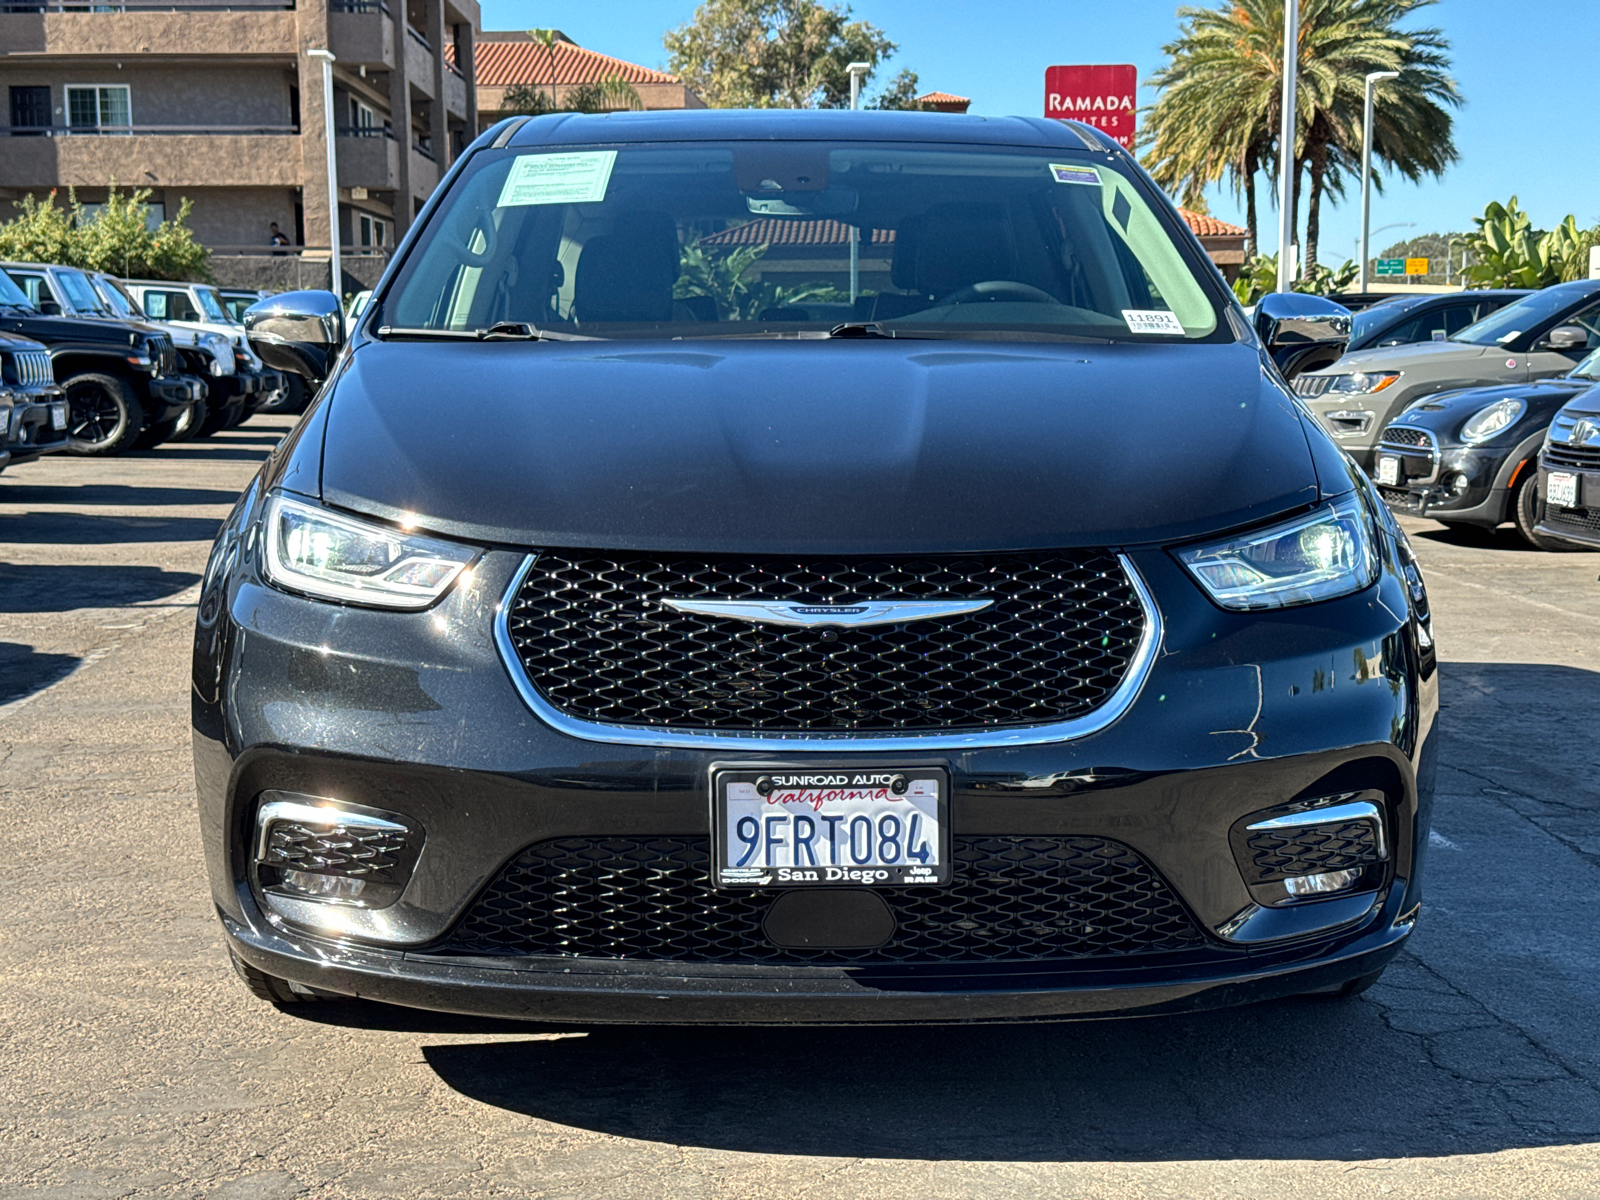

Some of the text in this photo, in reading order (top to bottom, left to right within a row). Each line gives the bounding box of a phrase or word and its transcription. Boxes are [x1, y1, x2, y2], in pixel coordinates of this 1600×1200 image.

[1049, 93, 1132, 111] RAMADA
[1060, 116, 1119, 127] ITES
[1127, 314, 1173, 323] 11891
[771, 775, 892, 786] SUNROAD AUTO
[767, 788, 904, 811] California
[736, 813, 930, 867] 9FRT084
[778, 867, 889, 884] San Diego
[909, 866, 932, 876] Jeep
